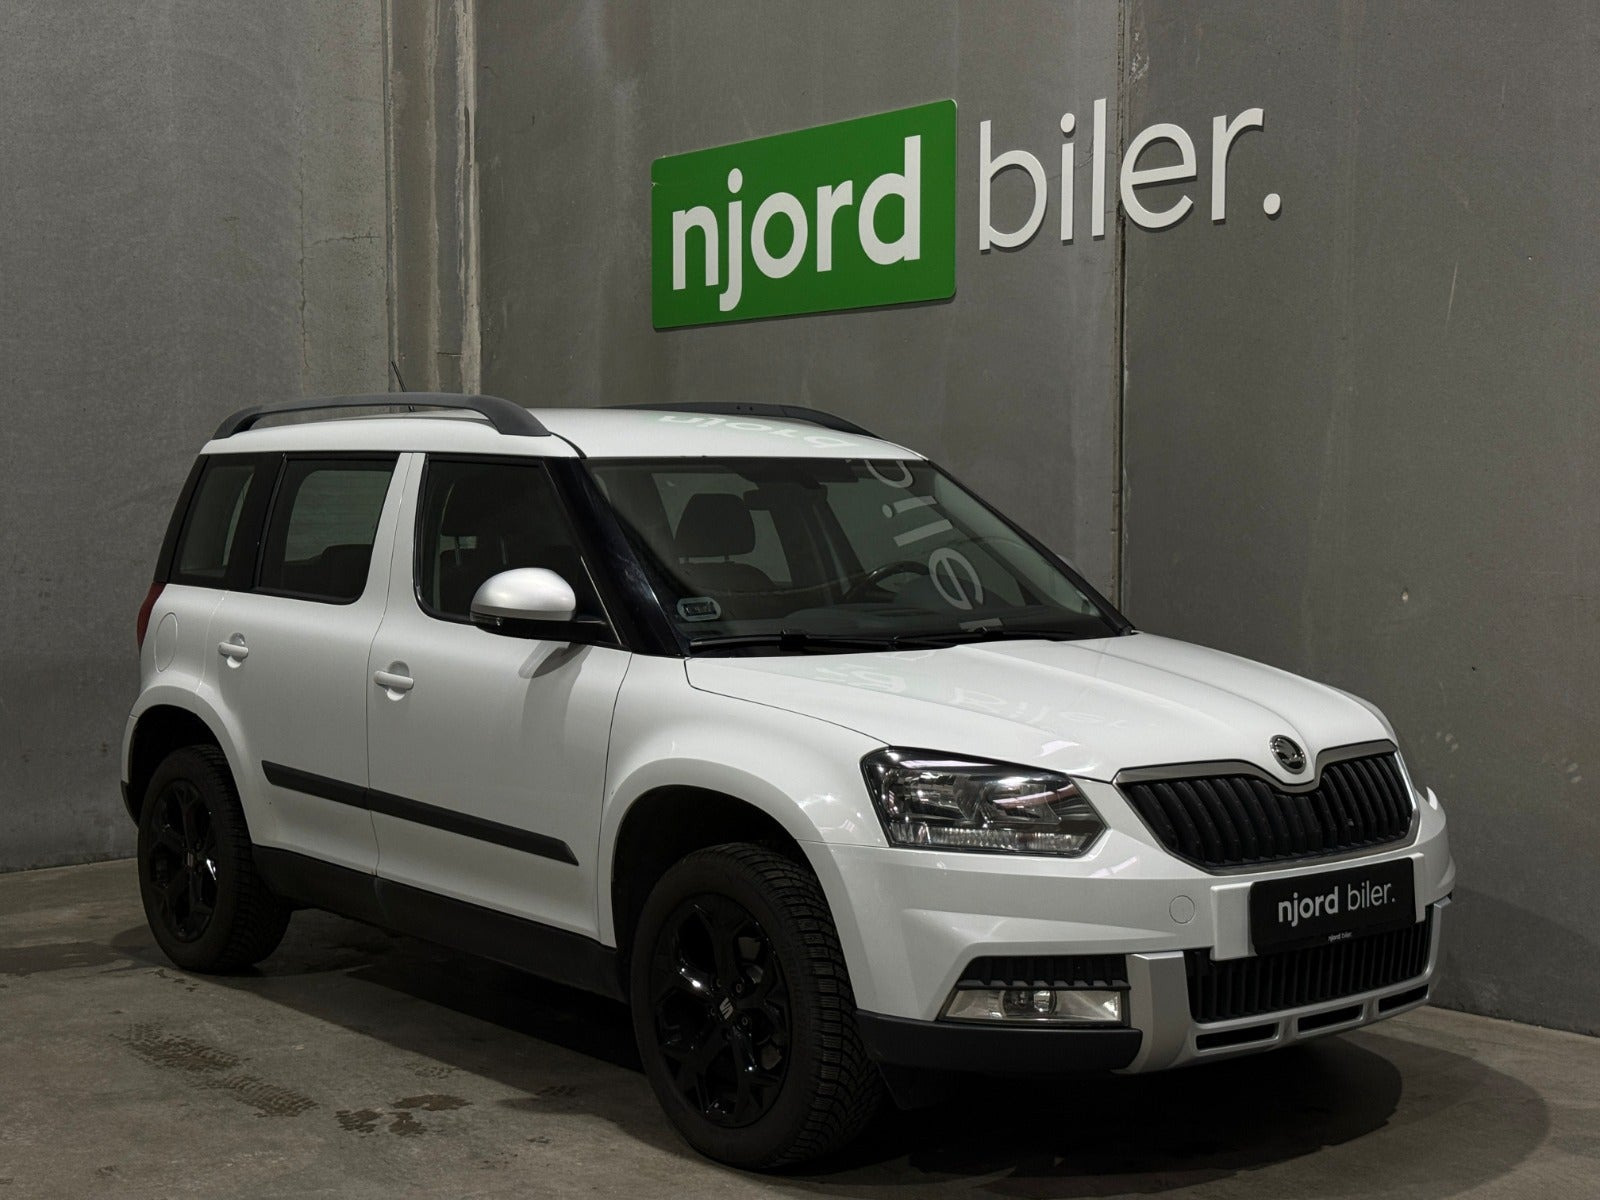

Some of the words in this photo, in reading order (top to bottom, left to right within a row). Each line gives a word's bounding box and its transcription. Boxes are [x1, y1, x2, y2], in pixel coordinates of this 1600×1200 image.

[672, 134, 921, 312] njord
[979, 97, 1282, 252] biler.
[1278, 886, 1339, 927] njord
[1348, 880, 1396, 911] biler.
